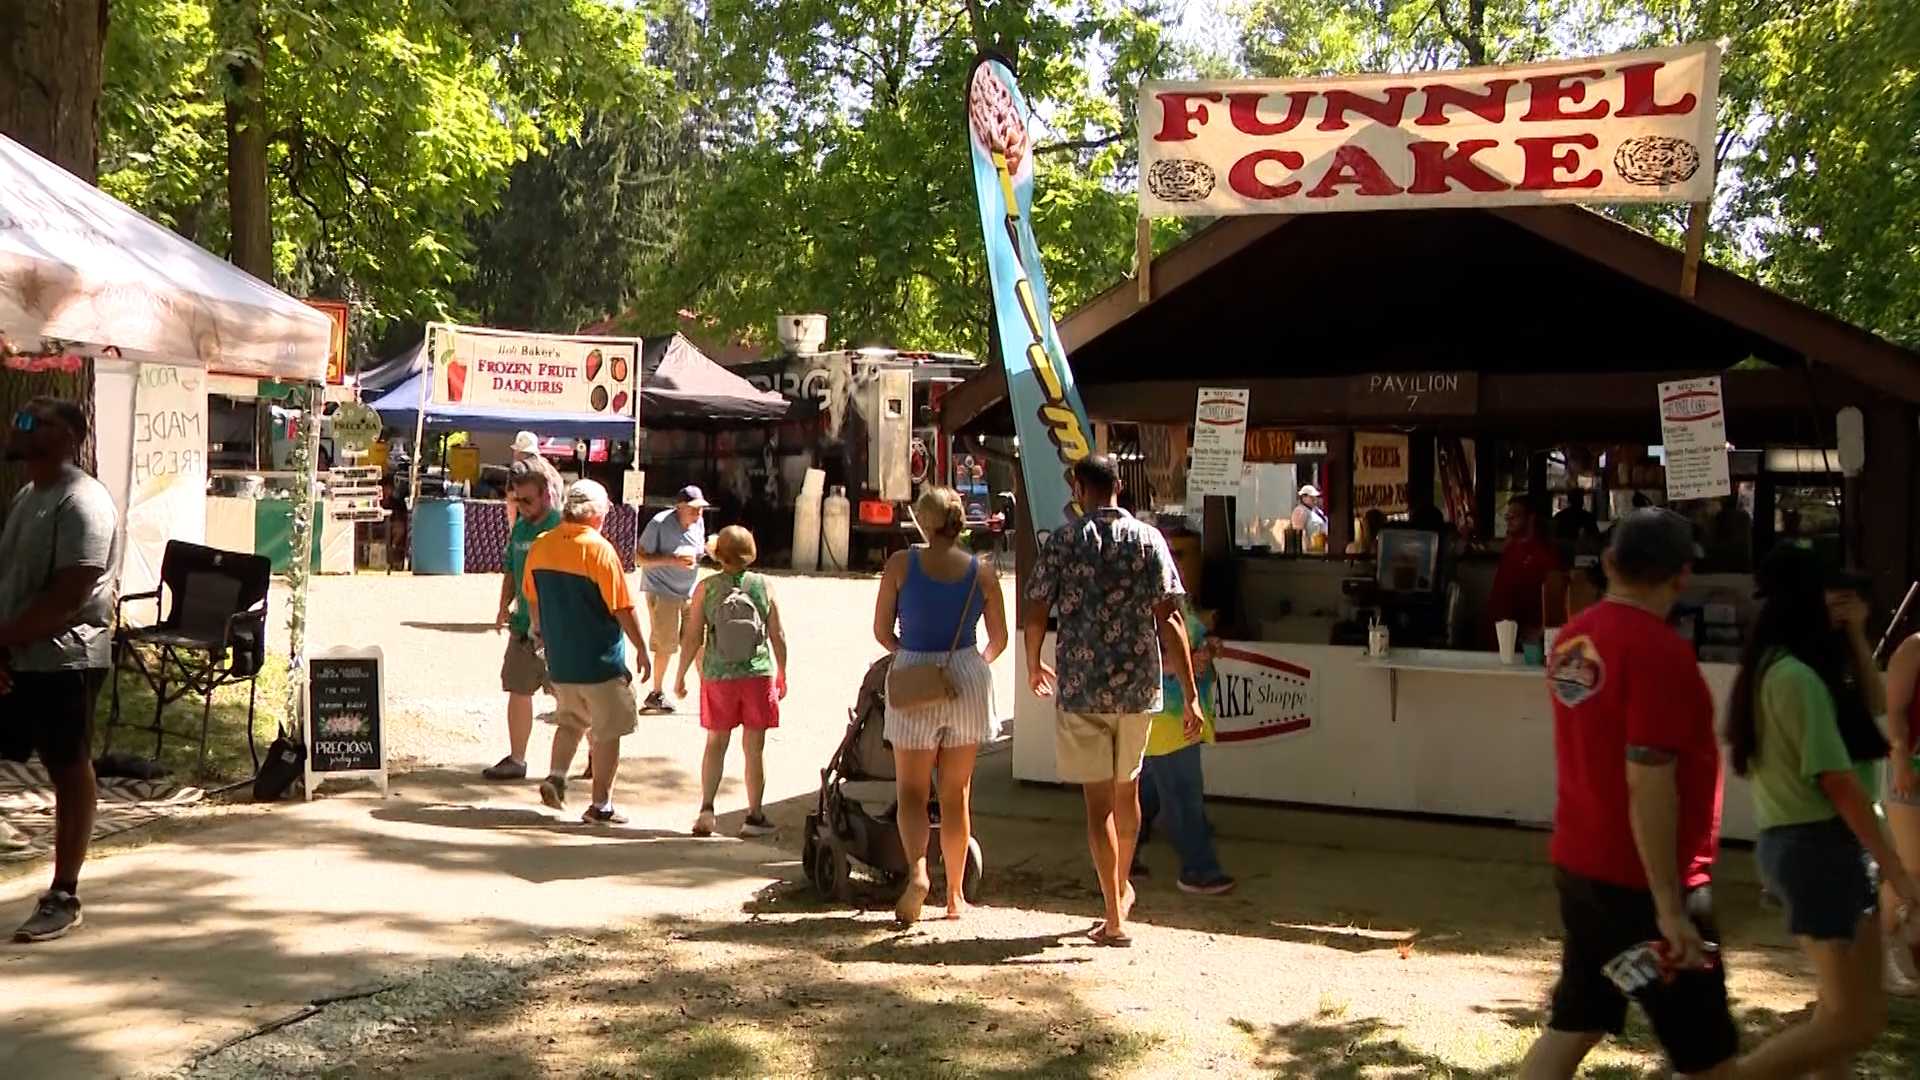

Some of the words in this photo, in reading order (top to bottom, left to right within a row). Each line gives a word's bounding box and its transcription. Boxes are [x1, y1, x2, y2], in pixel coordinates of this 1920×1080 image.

[1154, 62, 1697, 142] FUNNEL
[1228, 133, 1604, 200] CAKE
[478, 360, 532, 375] FROZEN
[538, 363, 577, 378] FRUIT
[492, 378, 563, 394] DAIQUIRIS
[1370, 376, 1458, 392] PAVILION
[1407, 396, 1417, 411] 7
[1215, 672, 1254, 718] AKE
[315, 741, 374, 754] PRECIOSA
